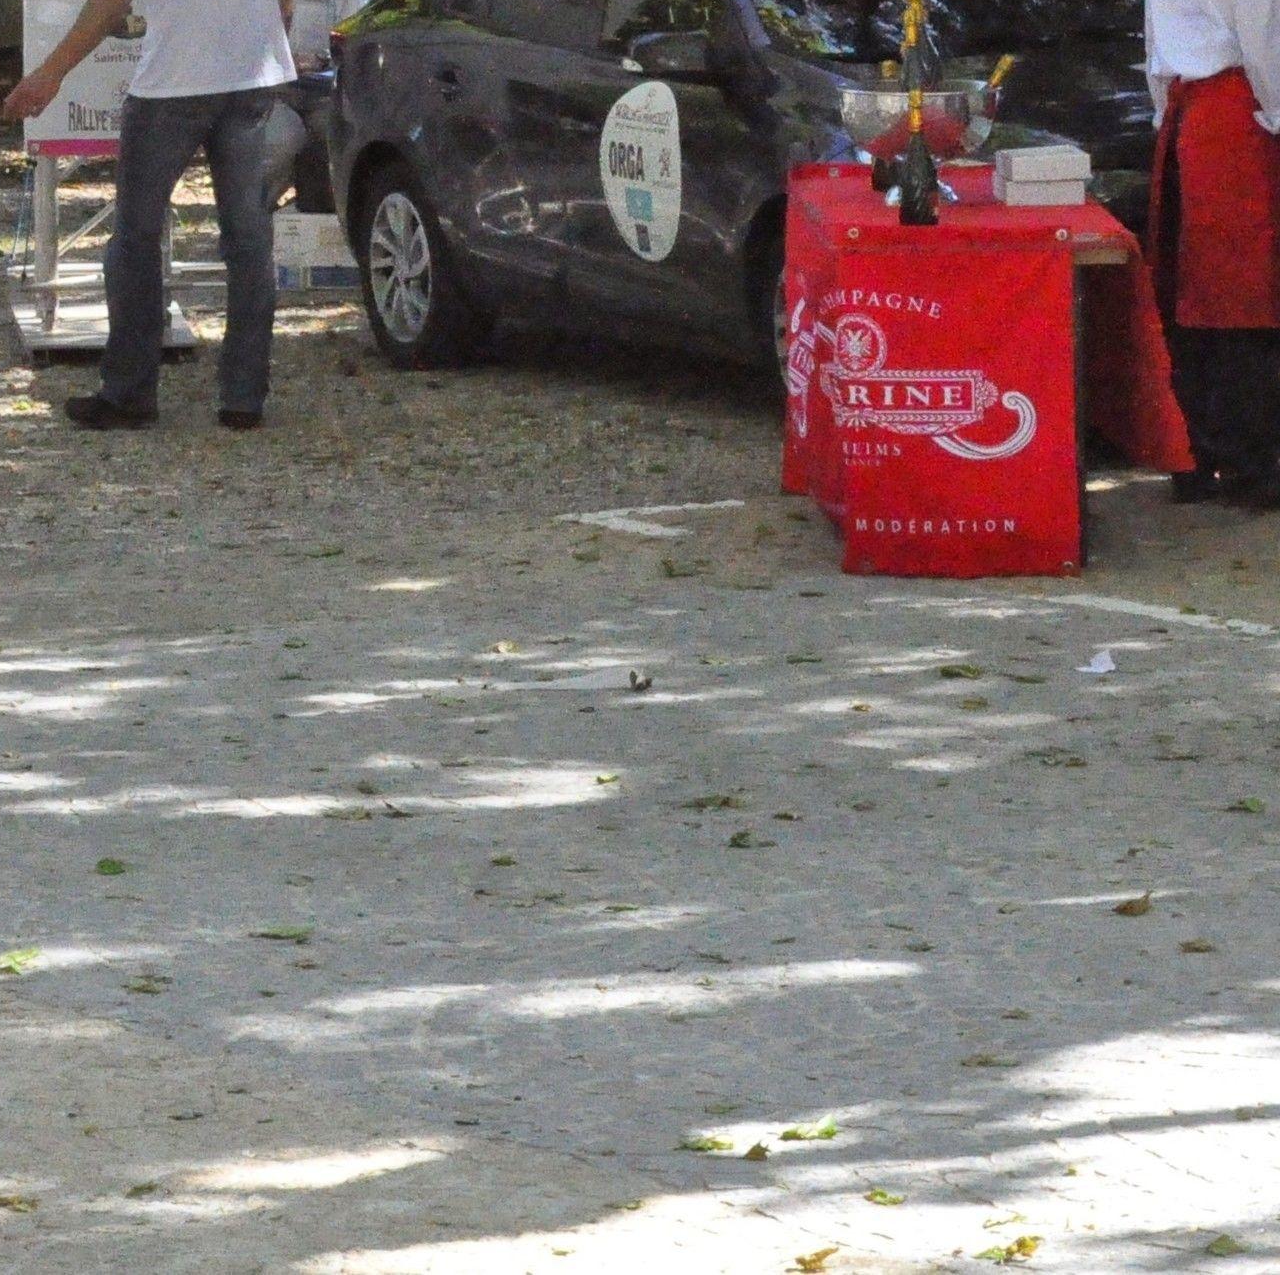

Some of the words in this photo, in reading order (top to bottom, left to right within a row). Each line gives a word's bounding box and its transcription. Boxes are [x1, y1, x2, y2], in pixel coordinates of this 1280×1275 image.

[68, 100, 109, 131] RALLYE
[608, 140, 646, 183] ORGA
[848, 384, 964, 406] RINE
